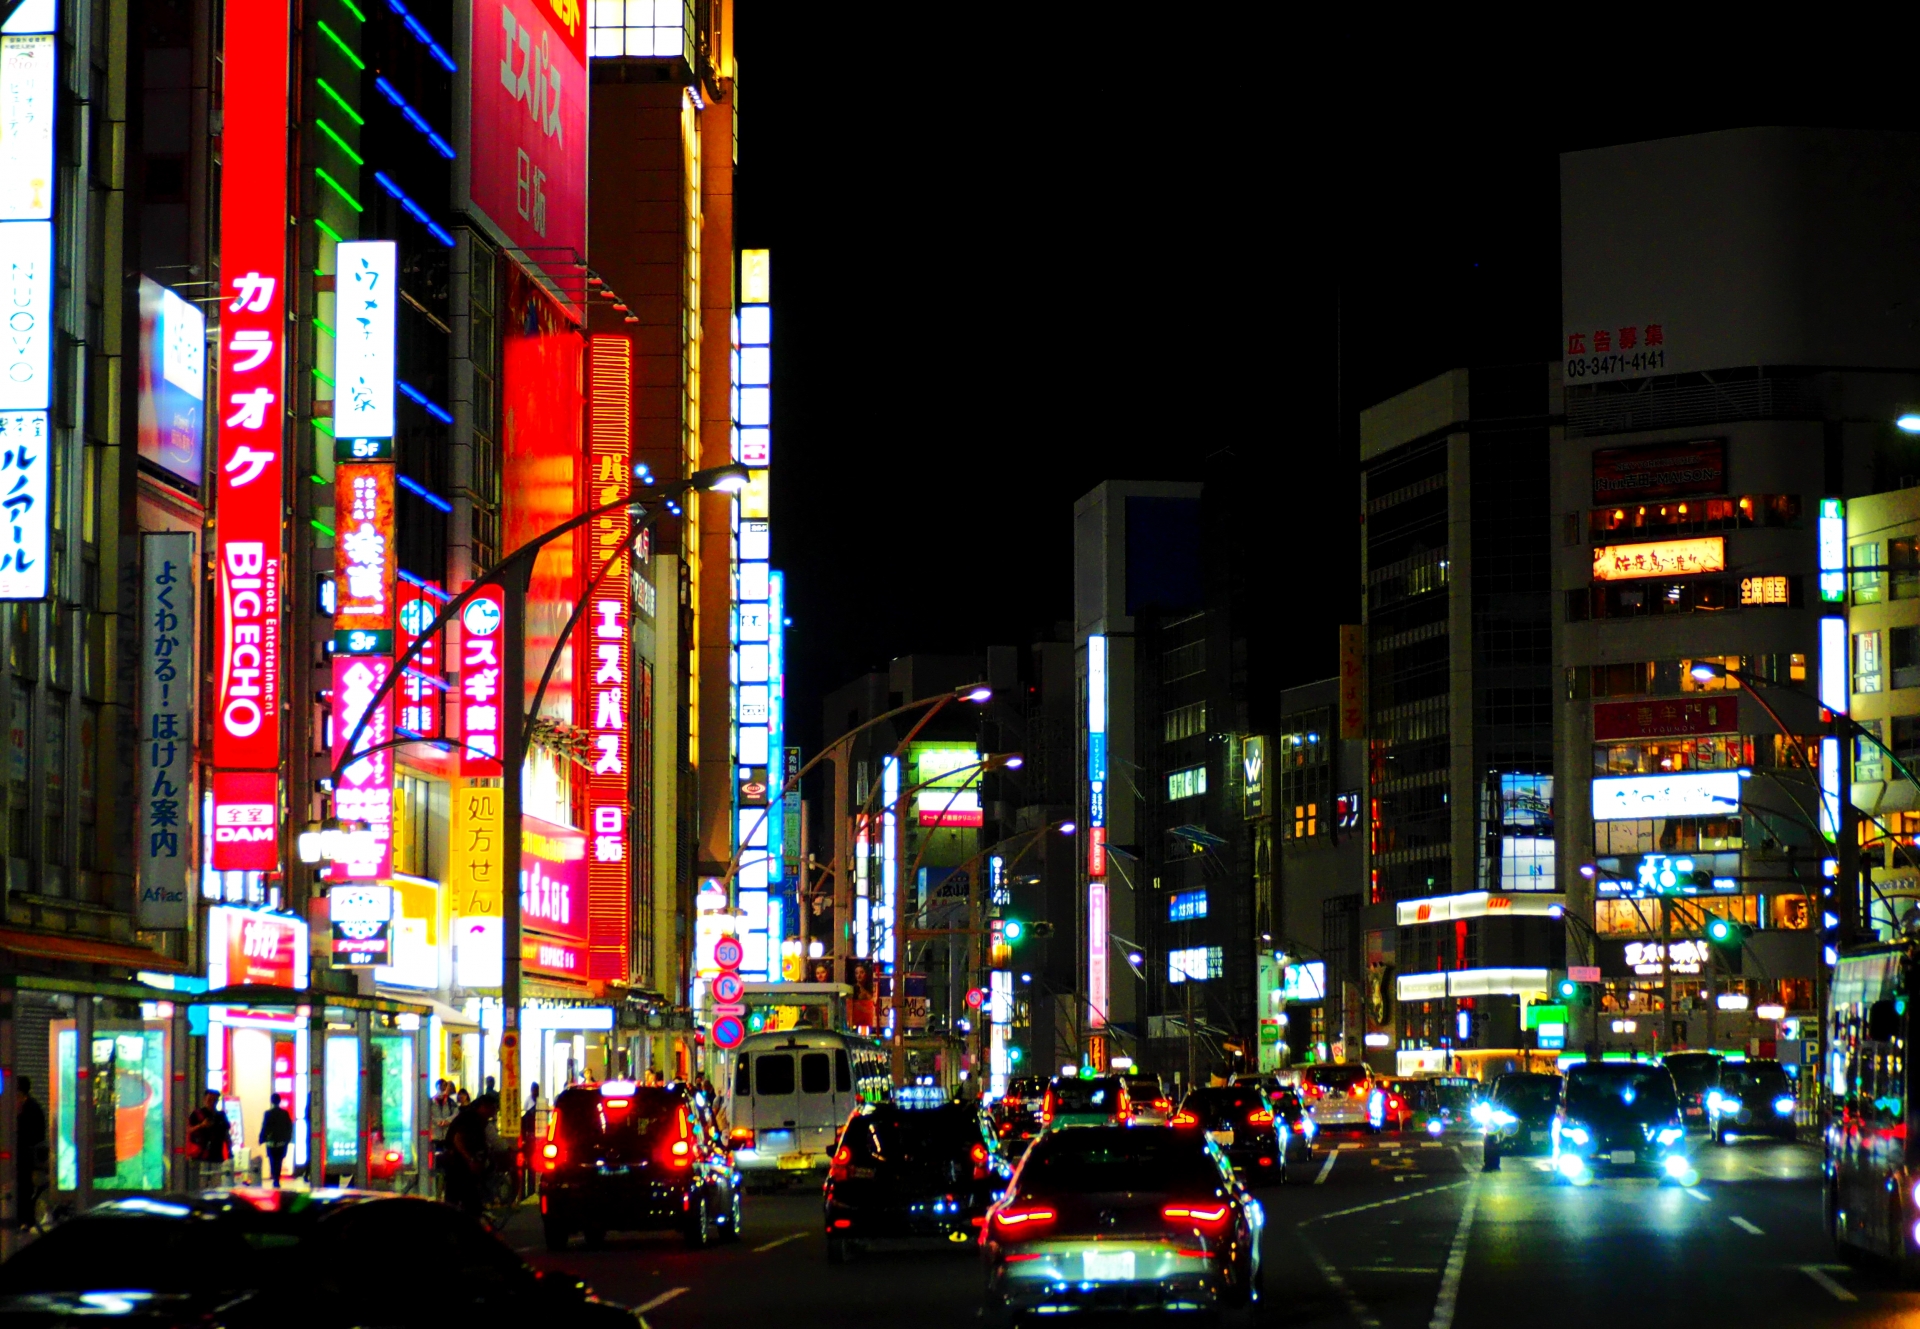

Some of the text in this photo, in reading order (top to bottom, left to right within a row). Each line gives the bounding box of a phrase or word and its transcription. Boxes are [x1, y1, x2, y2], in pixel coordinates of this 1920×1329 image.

[501, 4, 562, 150] エスパス
[1568, 324, 1664, 355] 広告募集
[224, 271, 277, 488] カラオケ
[1567, 350, 1666, 379] 03-3471-4141
[353, 439, 380, 457] 5F
[0, 444, 38, 574] ルノアール
[1740, 576, 1788, 605] 全席個室
[222, 541, 264, 738] BIG ECHO
[264, 558, 278, 718] Karaoke Entertainment
[350, 630, 377, 652] 3F
[464, 640, 497, 761] スギ薬局
[596, 601, 624, 775] エスパス
[227, 807, 263, 823] 全室
[216, 828, 273, 842] DAM
[468, 796, 494, 914] 処方せん
[143, 885, 183, 902] Aflac
[719, 945, 737, 963] 50
[1806, 1042, 1819, 1062] P
